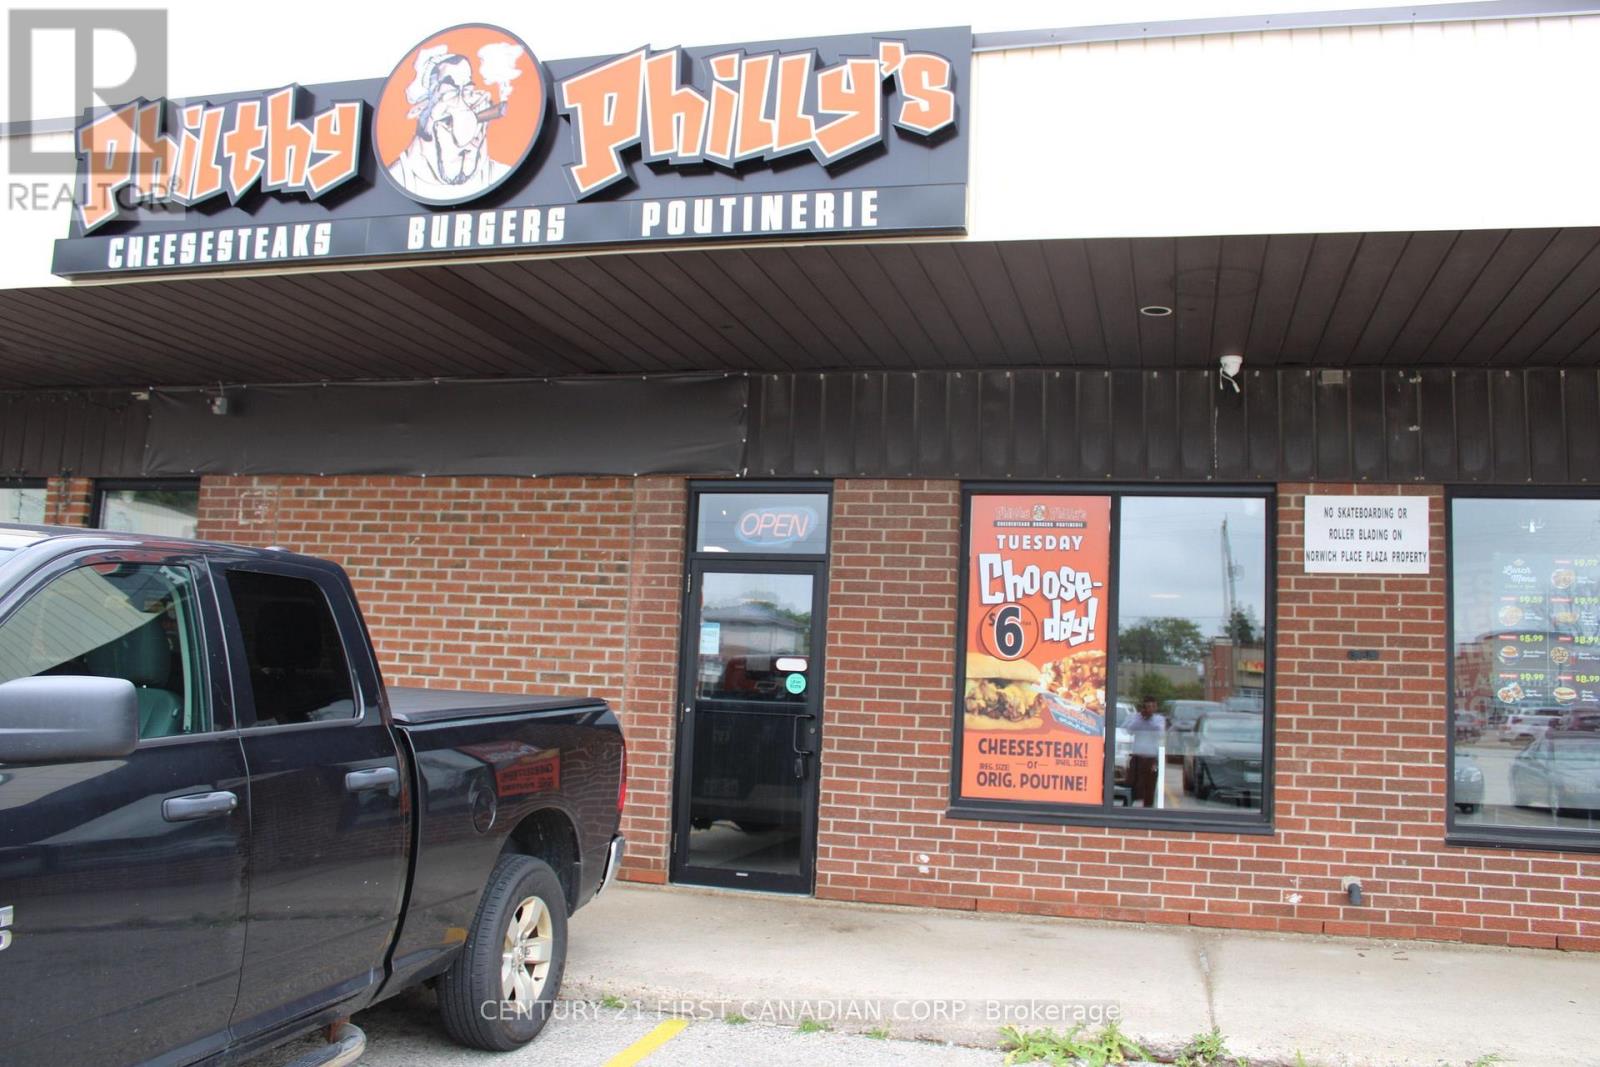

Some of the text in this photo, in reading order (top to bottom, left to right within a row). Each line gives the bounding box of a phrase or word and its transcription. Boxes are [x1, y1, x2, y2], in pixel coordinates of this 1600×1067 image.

[560, 39, 956, 194] Philly's
[641, 189, 879, 237] POUTINERIE
[407, 207, 566, 250] BURGERS
[108, 222, 332, 270] CHEESESTEAKS
[1323, 507, 1408, 519] NO SKATEBOARDING OR
[740, 512, 809, 537] OPEN
[1329, 528, 1402, 540] ROLLER BLADING ON
[996, 534, 1083, 550] TUESDAY
[1306, 551, 1427, 563] NORWICH PLACE PLAZA PROPERTY
[1043, 597, 1099, 647] day!
[978, 738, 1088, 759] CHEESESTEAK!
[1027, 761, 1038, 769] or
[976, 771, 1087, 791] ORIG. POUTINE!
